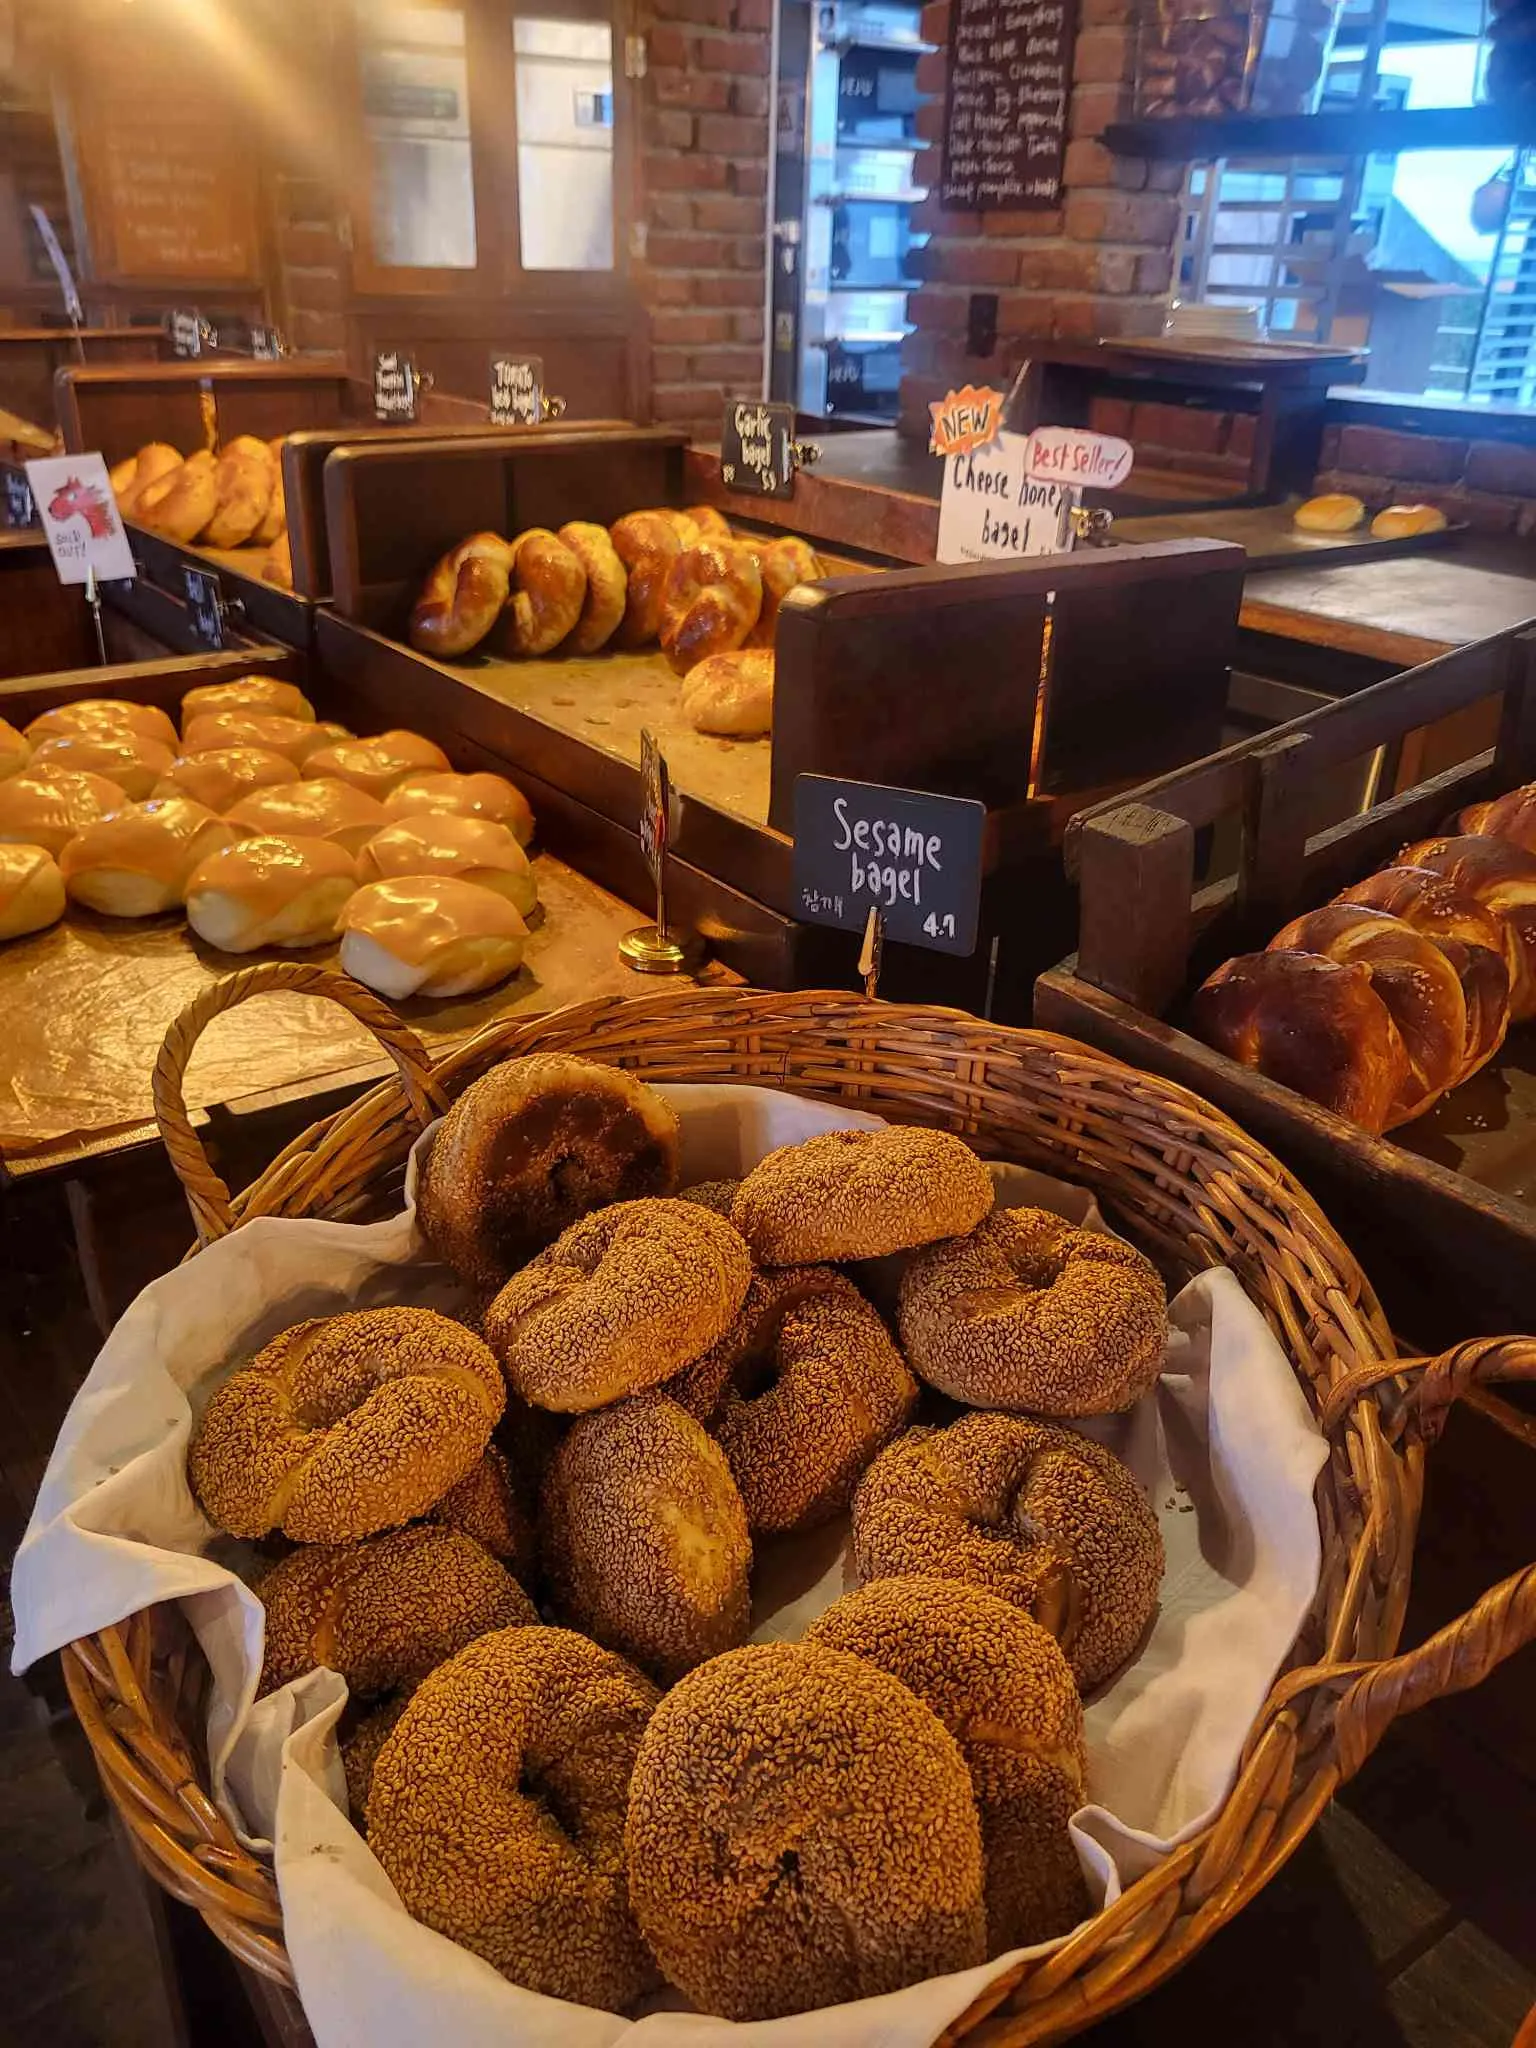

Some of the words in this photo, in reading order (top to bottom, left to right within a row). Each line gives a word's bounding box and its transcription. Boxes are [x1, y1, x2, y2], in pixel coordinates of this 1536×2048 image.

[941, 403, 990, 441] NEW
[953, 455, 1009, 499] Cheese
[982, 509, 1030, 553] bagel
[833, 798, 942, 871] Sesame
[851, 852, 921, 906] bagel
[922, 911, 956, 938] 4.7
